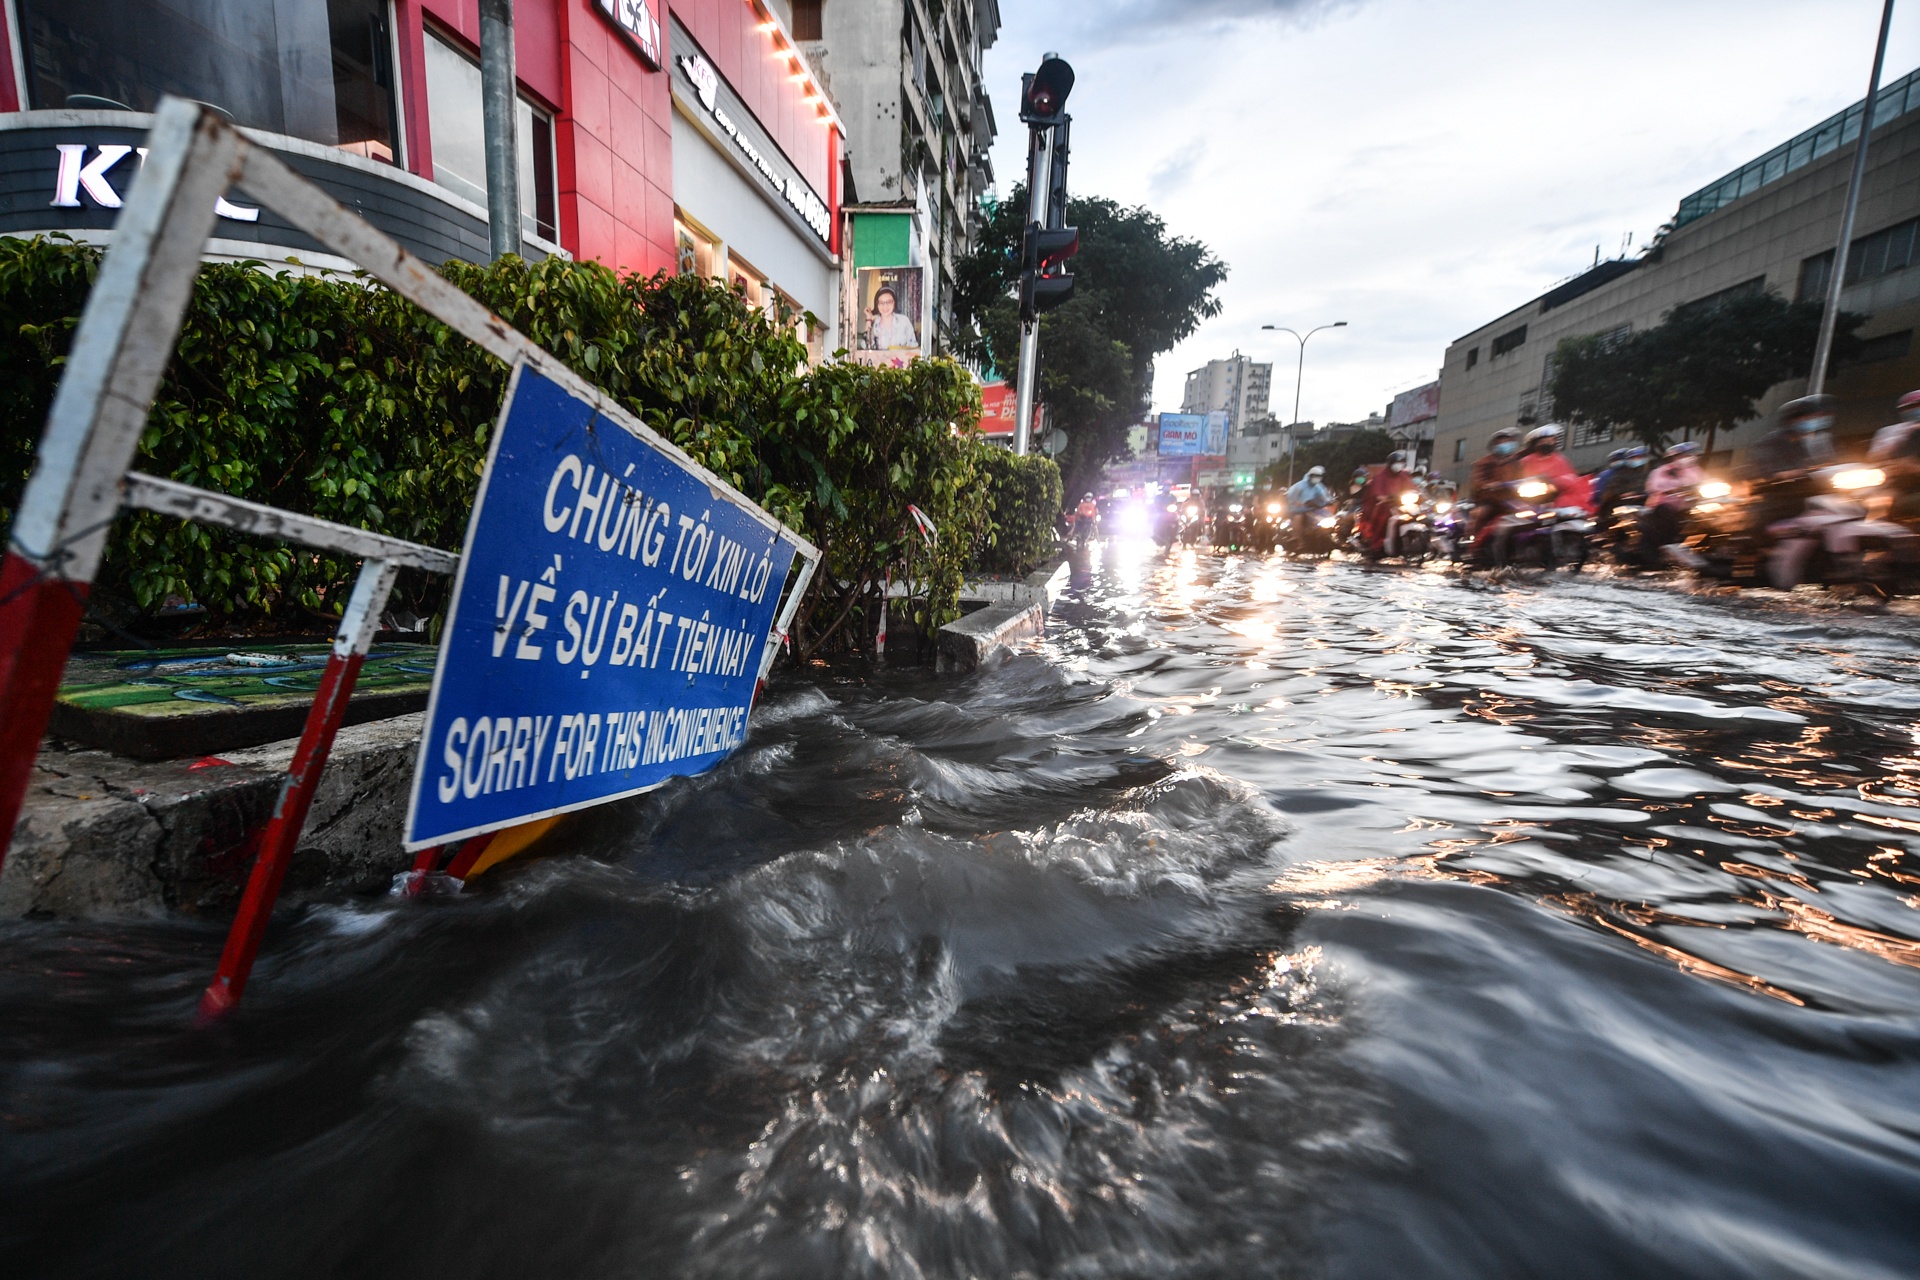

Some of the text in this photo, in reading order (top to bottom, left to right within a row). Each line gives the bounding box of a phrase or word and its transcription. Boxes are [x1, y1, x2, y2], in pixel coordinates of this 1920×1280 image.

[543, 454, 773, 604] CHÚNG TÔI XIN LỖI
[492, 554, 755, 681] VỀ SỰ BẤT TIỆN NÀY
[438, 706, 745, 803] SORRY FOR THIS INCONVENIENCE
